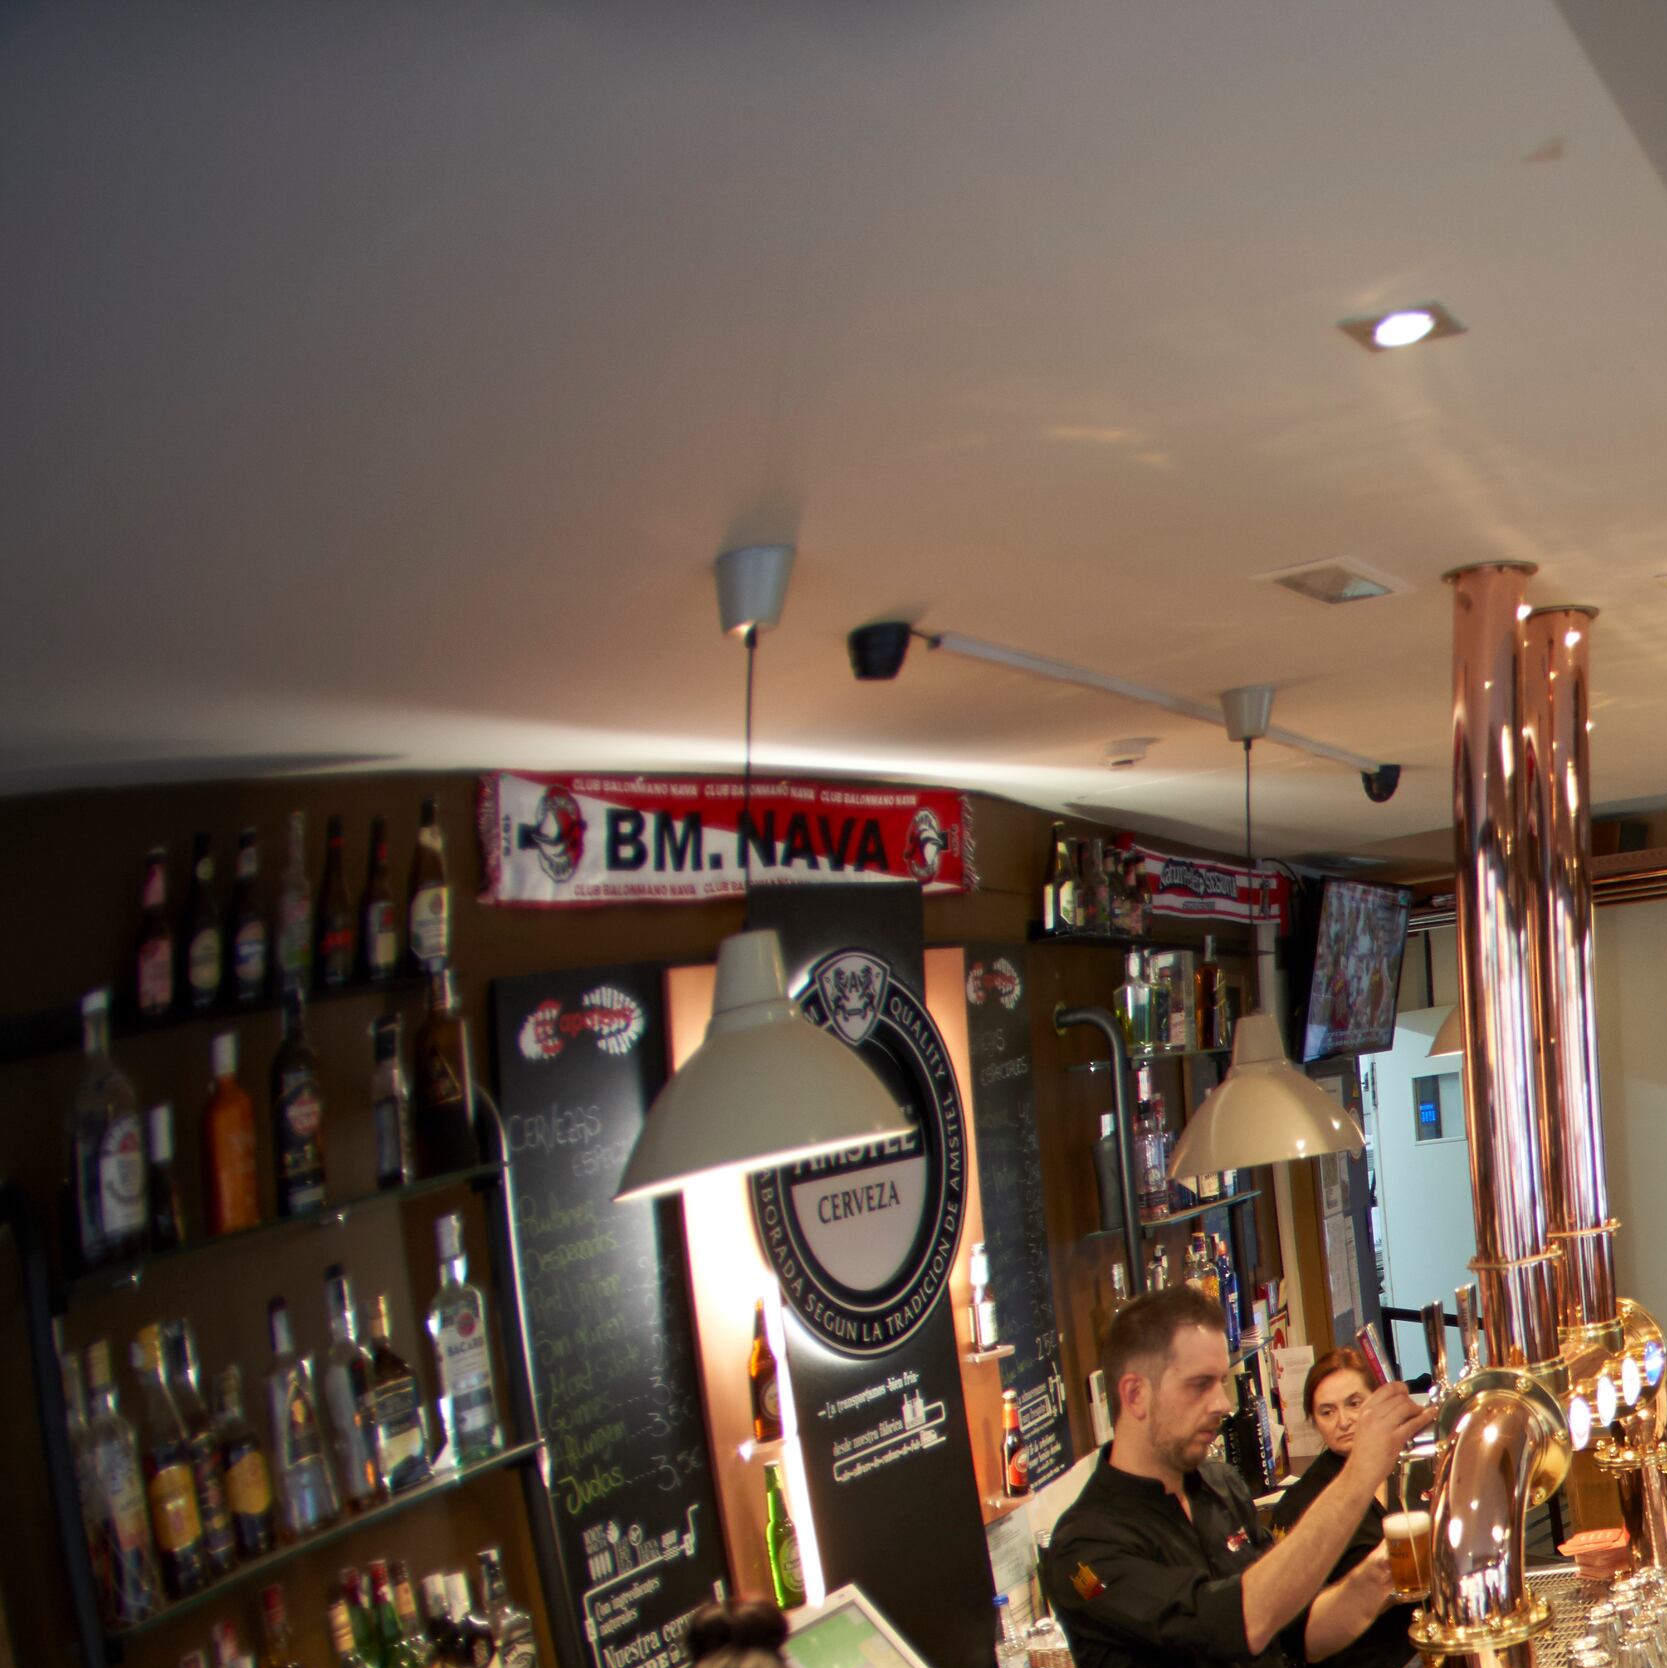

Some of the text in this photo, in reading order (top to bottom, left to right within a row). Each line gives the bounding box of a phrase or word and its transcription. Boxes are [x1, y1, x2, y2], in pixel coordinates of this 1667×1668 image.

[605, 807, 889, 872] BM. NAVA
[889, 996, 946, 1079] QUALITY
[946, 1091, 962, 1192] AMSTEL
[817, 1180, 901, 1225] CERVEZA
[944, 1200, 959, 1234] DE
[885, 1236, 952, 1336] TRADICION
[804, 1293, 858, 1341] SEGUN
[862, 1321, 882, 1342] LA
